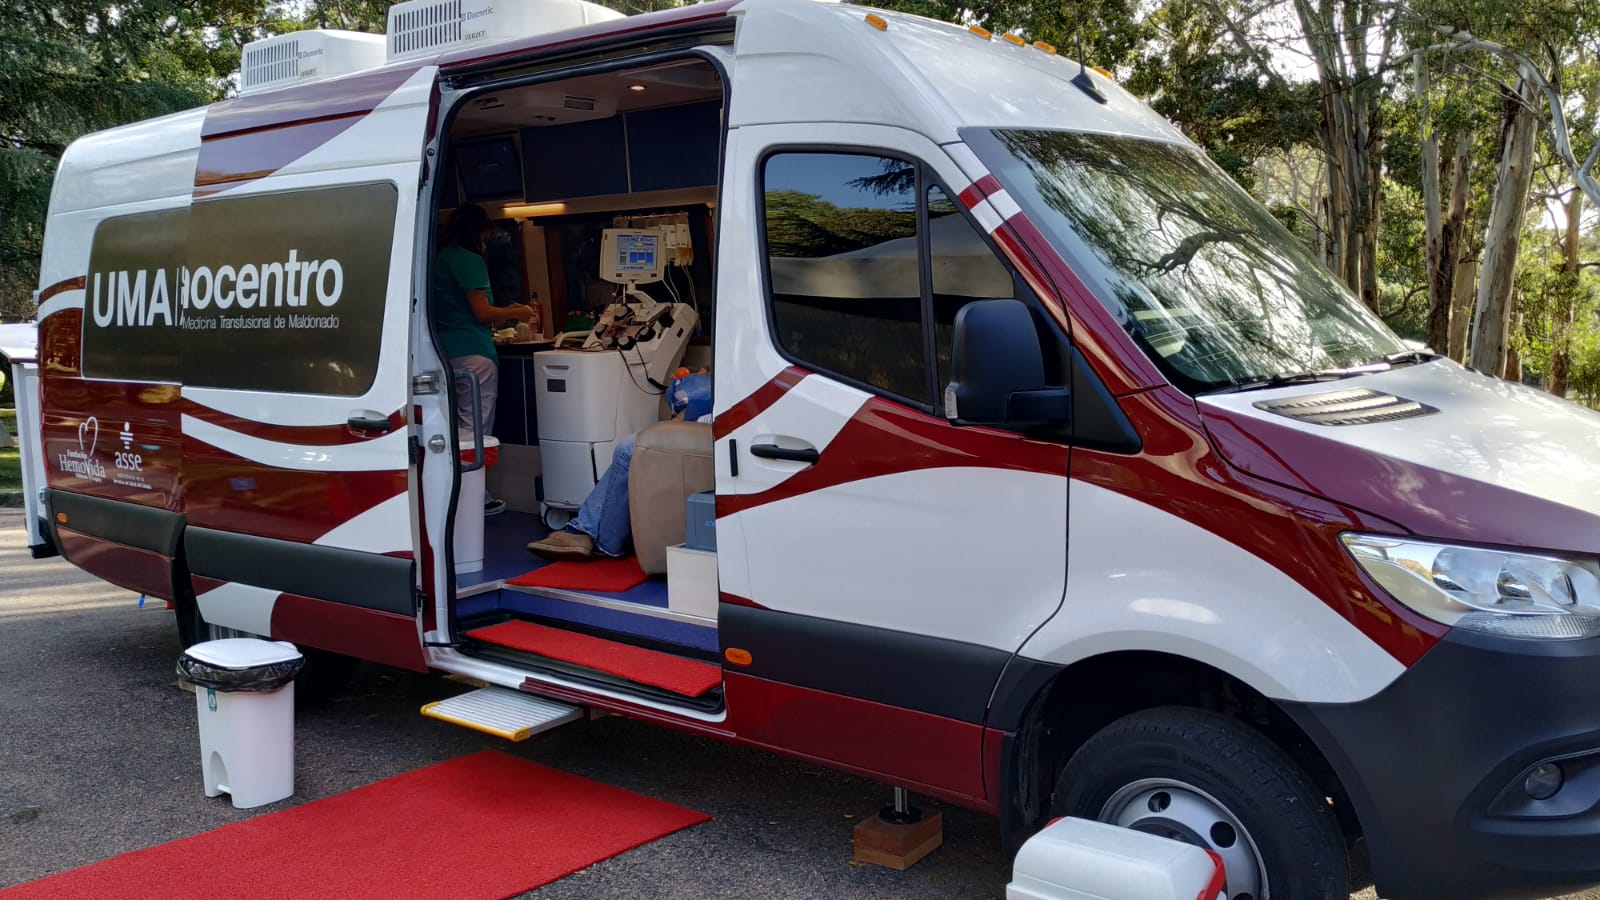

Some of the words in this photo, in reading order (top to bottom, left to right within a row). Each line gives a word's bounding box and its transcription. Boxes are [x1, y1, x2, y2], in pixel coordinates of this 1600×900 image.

[467, 5, 495, 21] Dometic
[303, 47, 324, 59] Dometic
[93, 268, 172, 327] UMA
[182, 315, 217, 330] Medicina
[219, 314, 271, 329] Transfusional
[273, 314, 286, 329] de
[288, 313, 340, 329] Maldonado
[58, 453, 107, 481] HemoVida
[114, 451, 143, 472] asse
